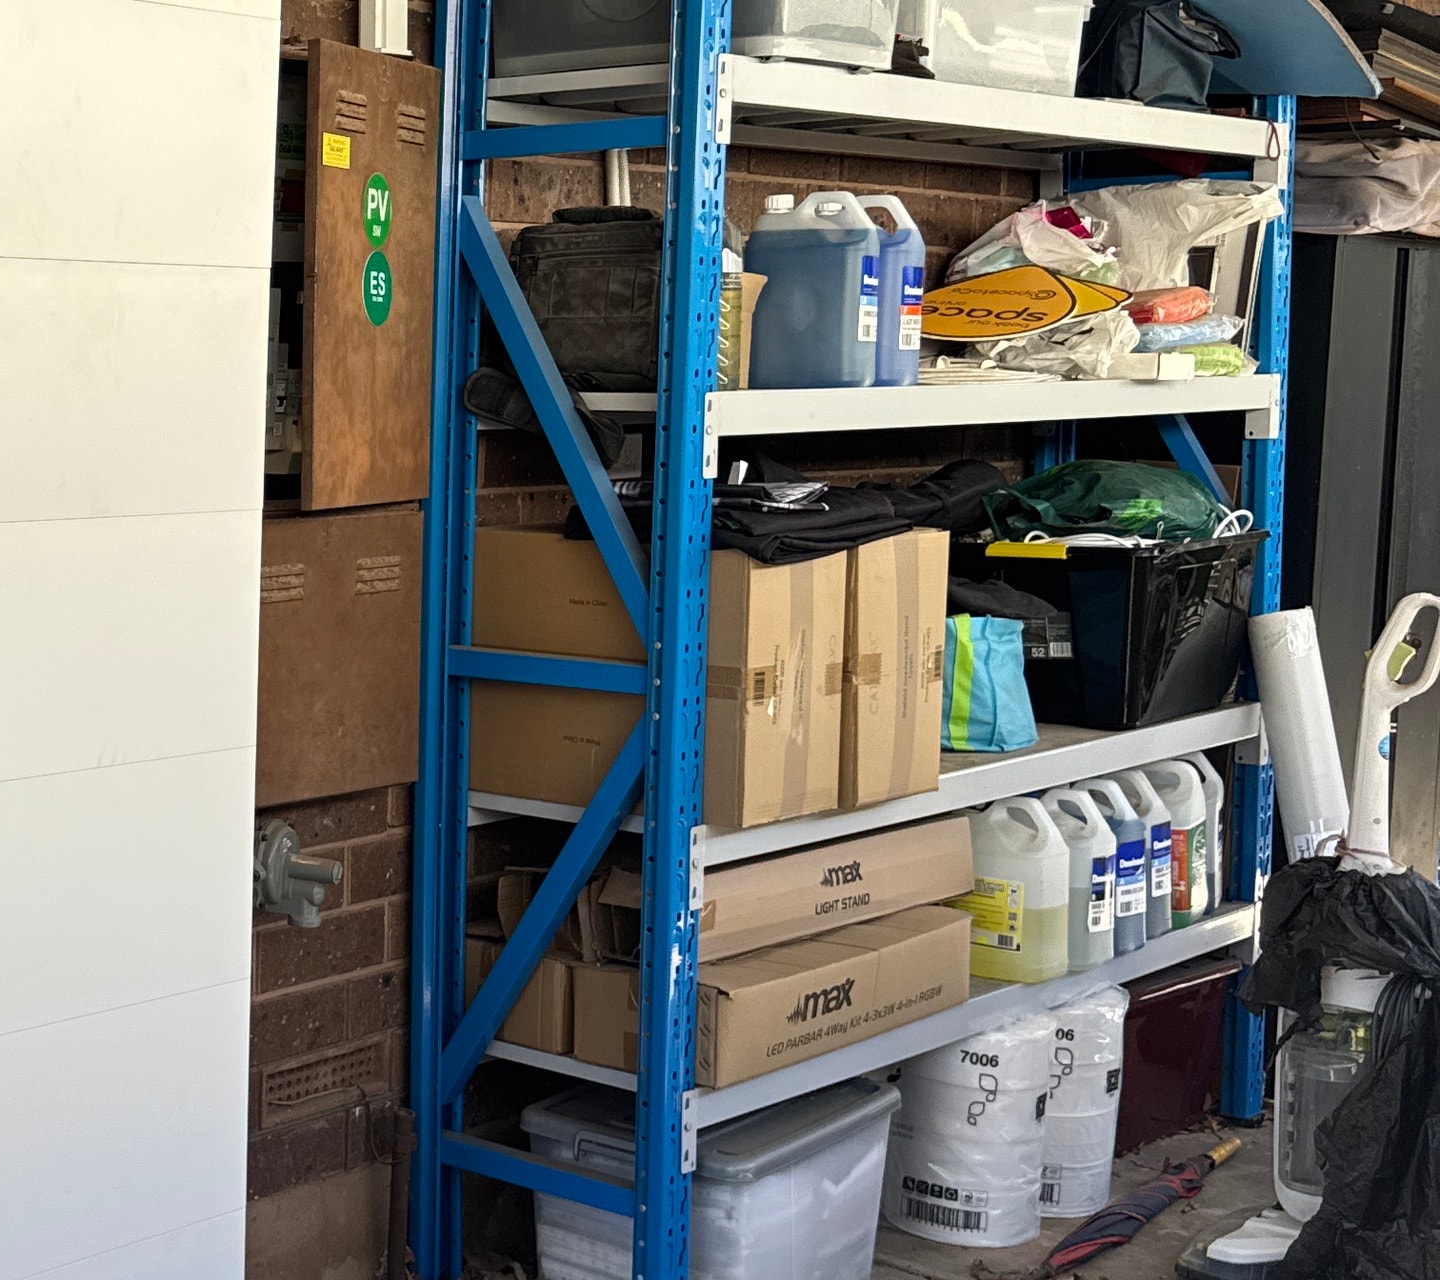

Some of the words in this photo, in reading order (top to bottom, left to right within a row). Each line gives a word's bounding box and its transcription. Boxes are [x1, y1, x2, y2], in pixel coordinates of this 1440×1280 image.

[367, 187, 389, 221] PV
[370, 271, 386, 296] ES
[921, 305, 1049, 322] space
[1031, 647, 1046, 658] 52
[815, 899, 840, 915] LIGHT
[841, 893, 870, 910] STAND
[766, 1041, 785, 1058] LED
[785, 1028, 824, 1051] PARBAR
[823, 1021, 849, 1037] 4Way
[849, 1015, 862, 1030] Kit
[918, 984, 943, 1004] RGBW
[960, 1050, 1000, 1068] 7006
